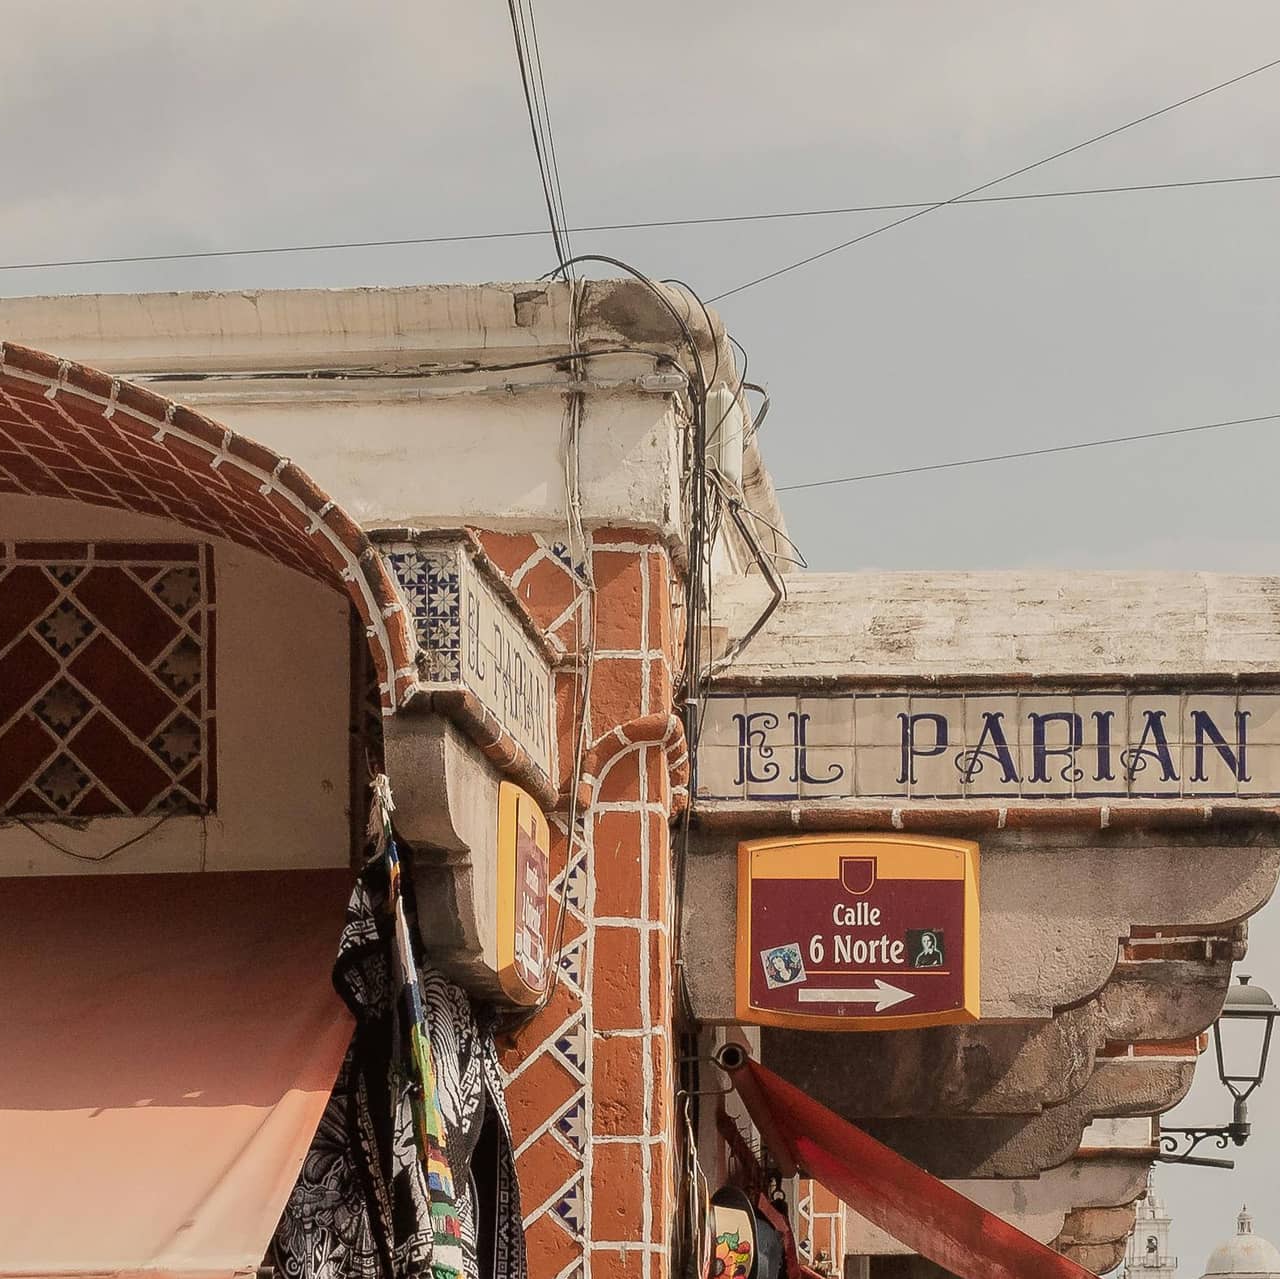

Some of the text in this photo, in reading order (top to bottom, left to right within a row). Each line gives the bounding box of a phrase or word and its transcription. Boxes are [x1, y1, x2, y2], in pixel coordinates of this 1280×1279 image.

[467, 589, 547, 757] EL PARIAN
[732, 710, 1252, 785] EL PARIAN
[833, 902, 881, 926] Calle
[809, 934, 905, 964] 6 Norte
